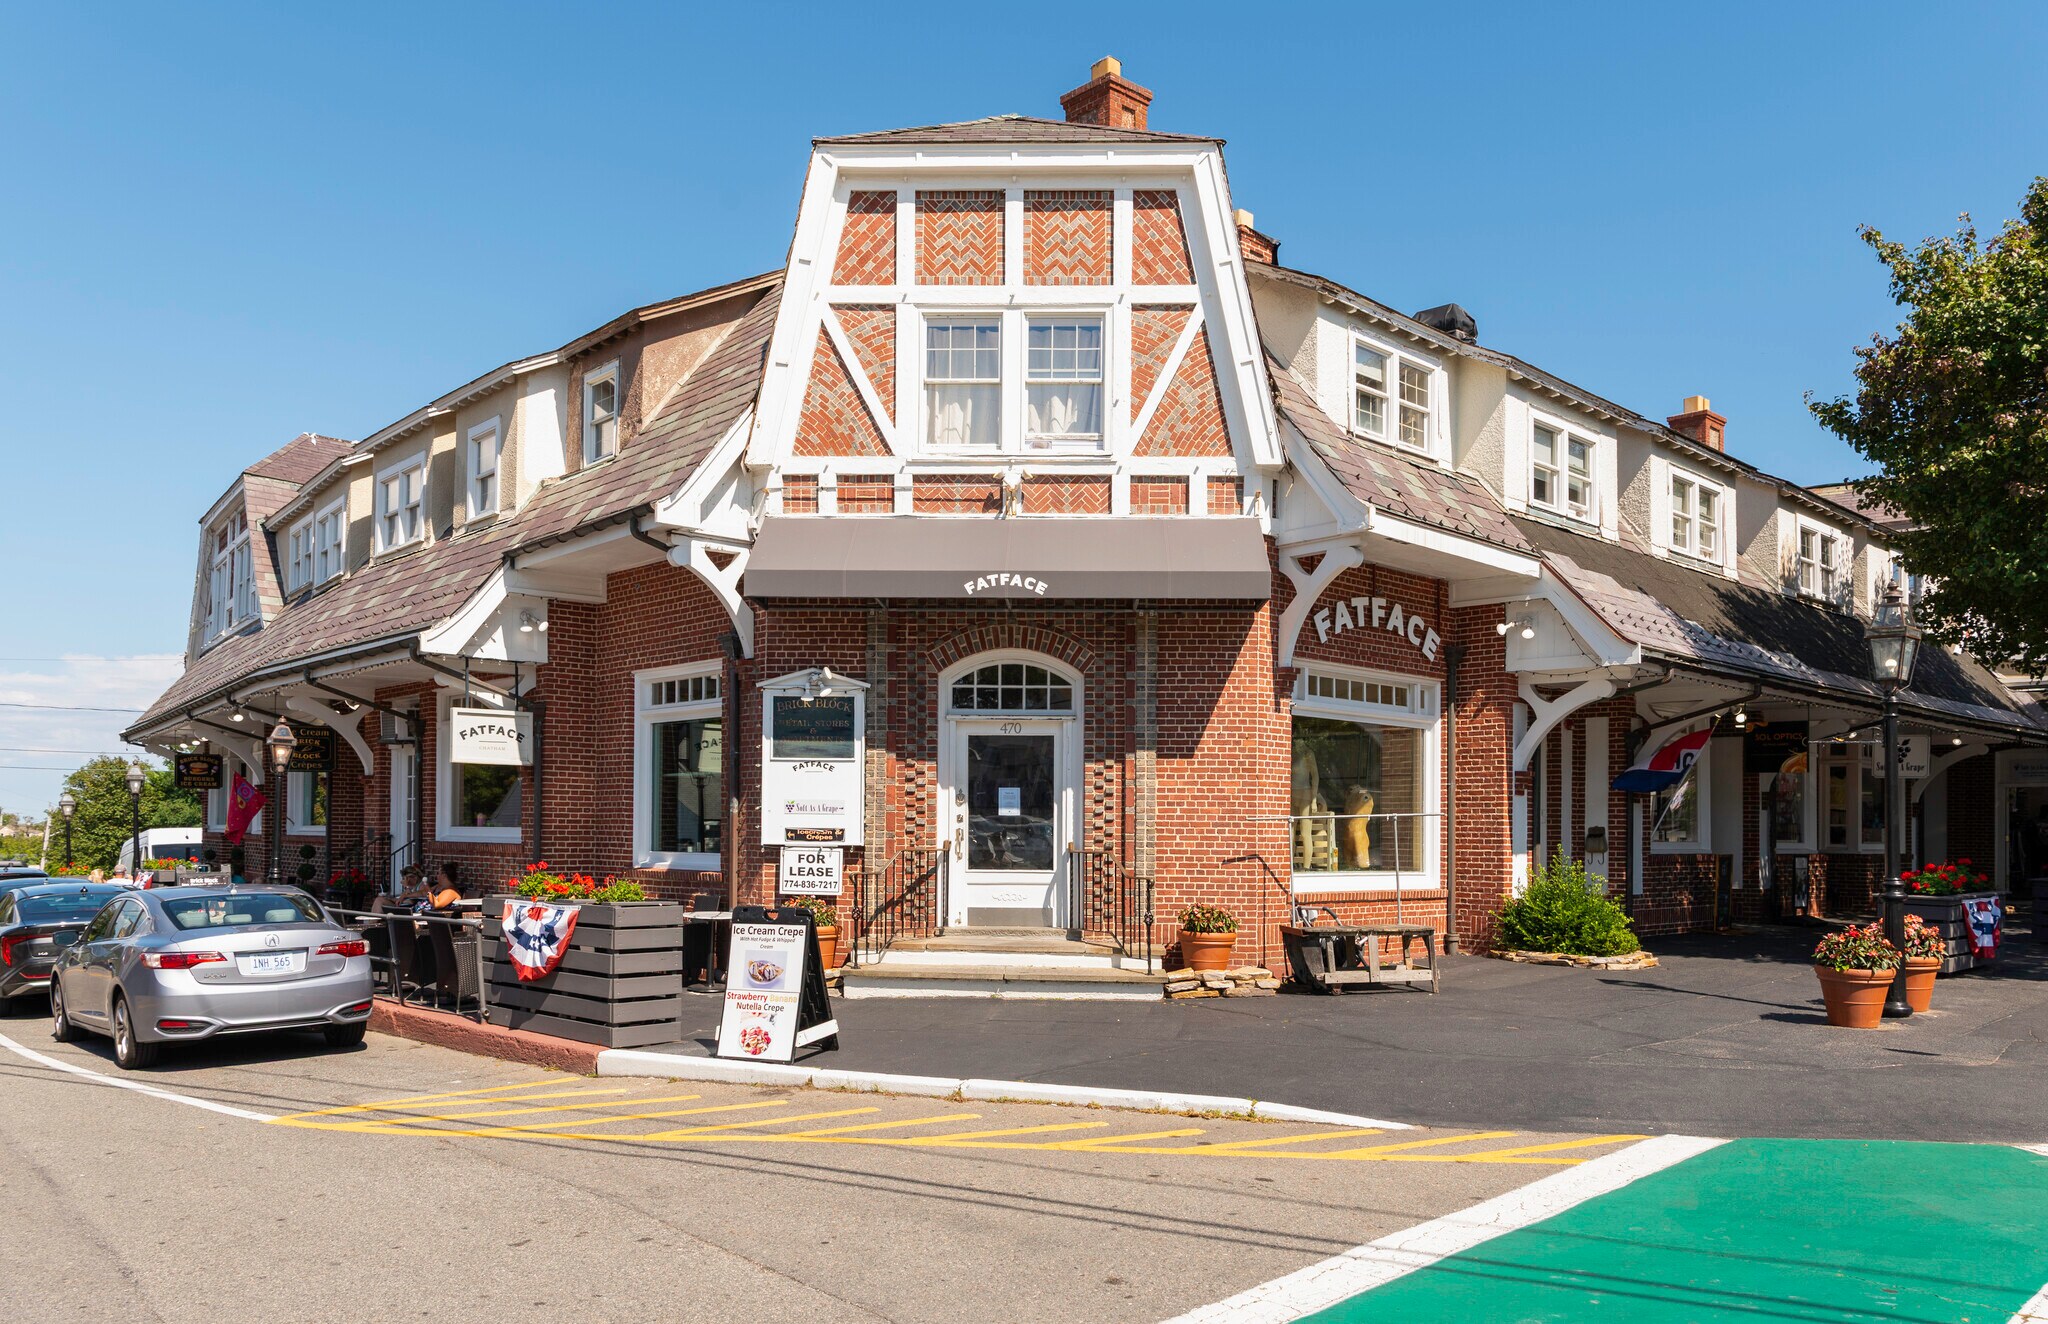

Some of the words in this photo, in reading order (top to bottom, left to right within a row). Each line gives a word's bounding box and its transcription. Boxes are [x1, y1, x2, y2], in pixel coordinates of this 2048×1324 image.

[963, 573, 1049, 596] FATFACE
[1313, 596, 1441, 662] FATFACE
[777, 699, 812, 712] BRICK
[815, 699, 851, 712] BLOCK
[779, 719, 811, 727] ETAIL
[1000, 722, 1022, 734] 470
[300, 728, 330, 736] Cream
[459, 725, 525, 743] FATFACE
[1773, 732, 1803, 741] OPTICS
[296, 738, 321, 747] RICK
[792, 761, 835, 772] FATFACE
[797, 853, 826, 864] FOR
[789, 866, 834, 877] LEASE
[784, 879, 838, 889] 774-836-7217
[733, 925, 746, 935] Ice
[748, 926, 775, 935] Cream
[778, 926, 804, 938] Crepe
[253, 958, 270, 969] 1NH
[274, 956, 291, 967] 565
[727, 992, 768, 1002] Strawberry
[736, 1001, 763, 1011] Nutella
[763, 1003, 785, 1013] Crepe
